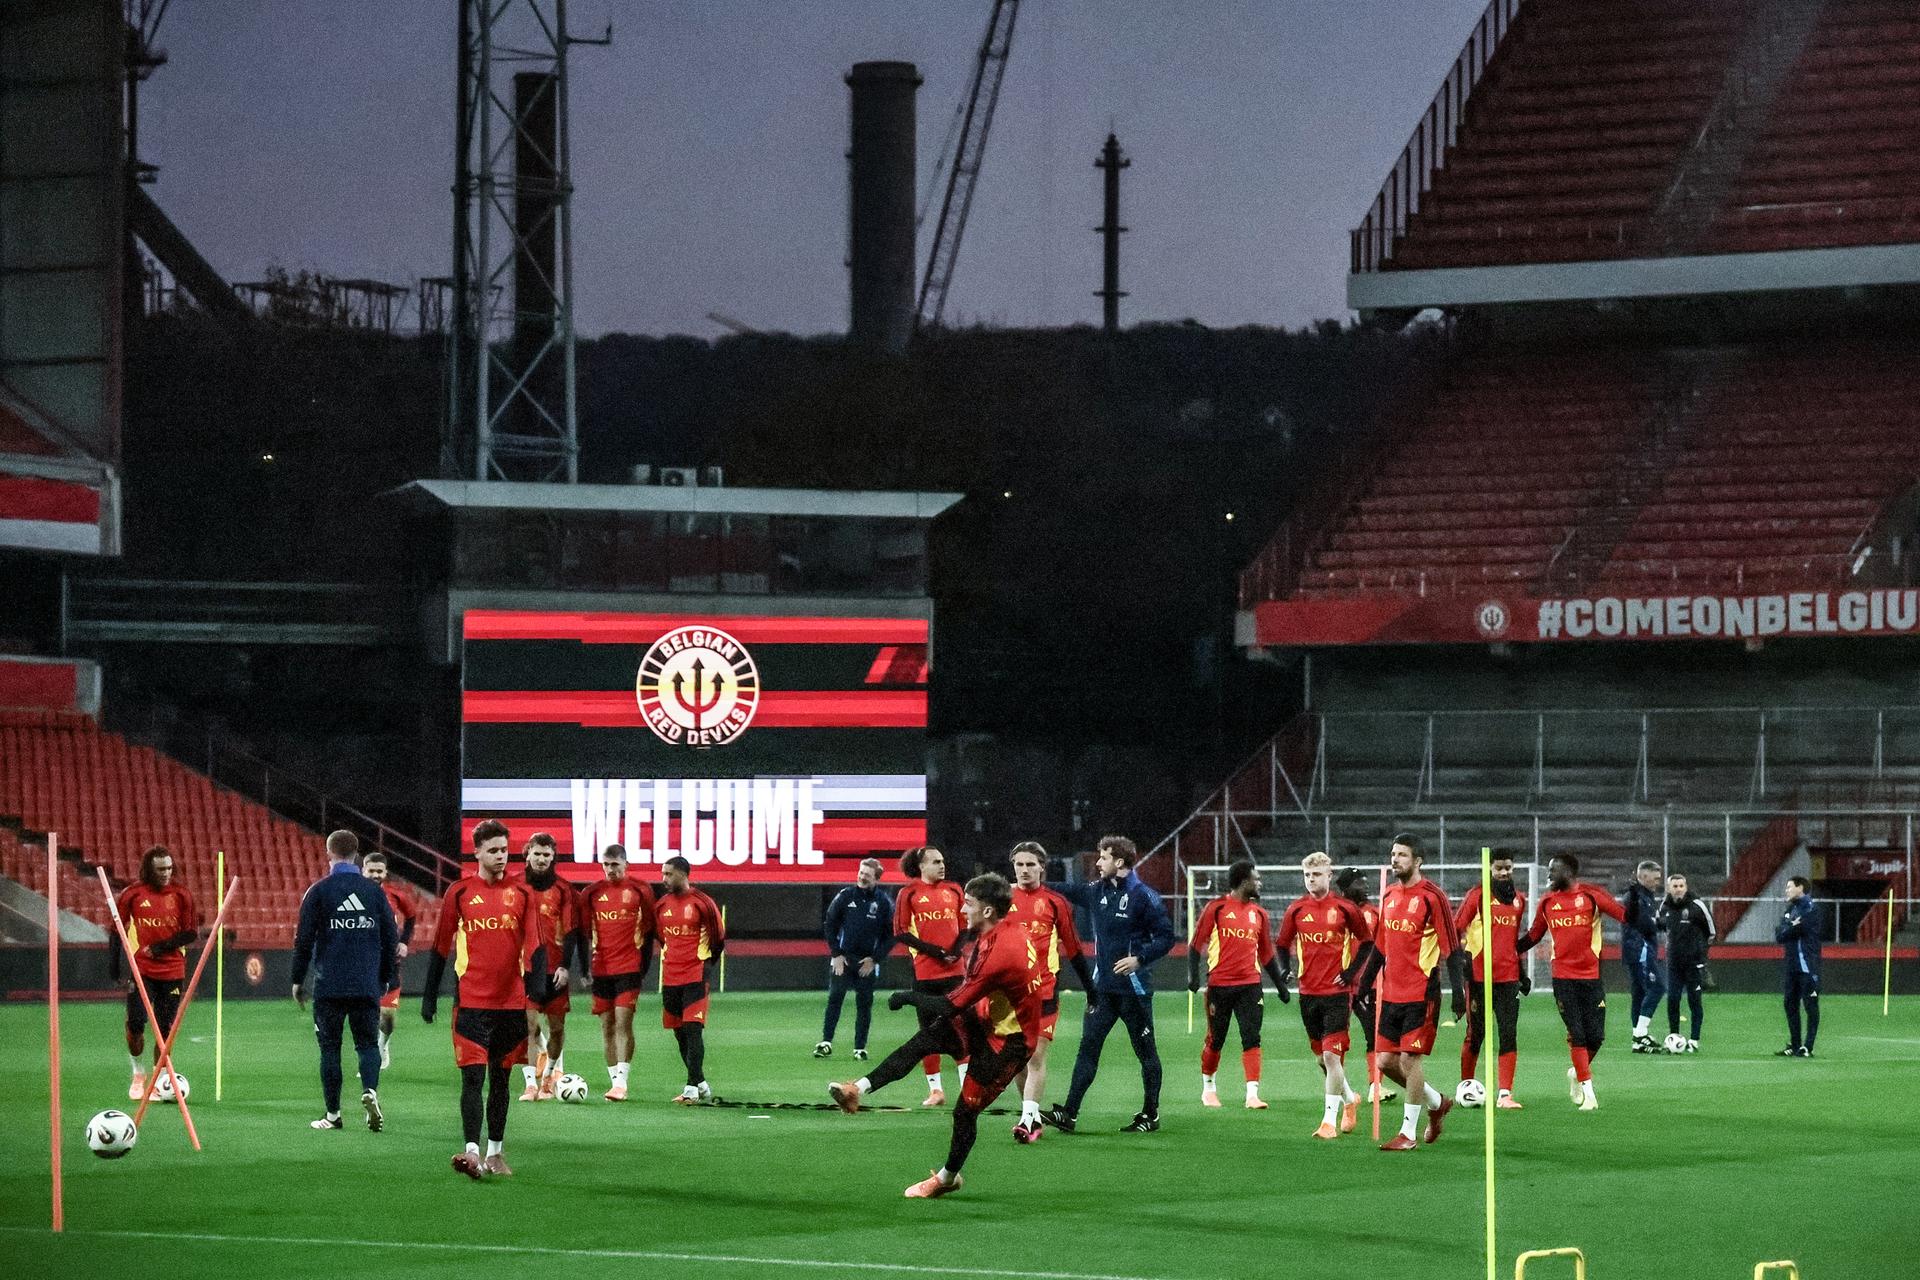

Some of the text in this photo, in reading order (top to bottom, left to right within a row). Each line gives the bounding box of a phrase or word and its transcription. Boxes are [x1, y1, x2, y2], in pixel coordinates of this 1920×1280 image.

[659, 631, 737, 660] BELGIAN
[649, 707, 747, 745] RED DEVILS
[571, 778, 824, 866] WELCOME
[596, 911, 617, 921] ING
[918, 911, 941, 921] ING
[138, 917, 161, 927] ING
[330, 918, 355, 929] ING
[467, 917, 498, 932] ING
[1551, 917, 1572, 929] ING
[1222, 927, 1245, 938] ING
[1300, 932, 1323, 943] ING
